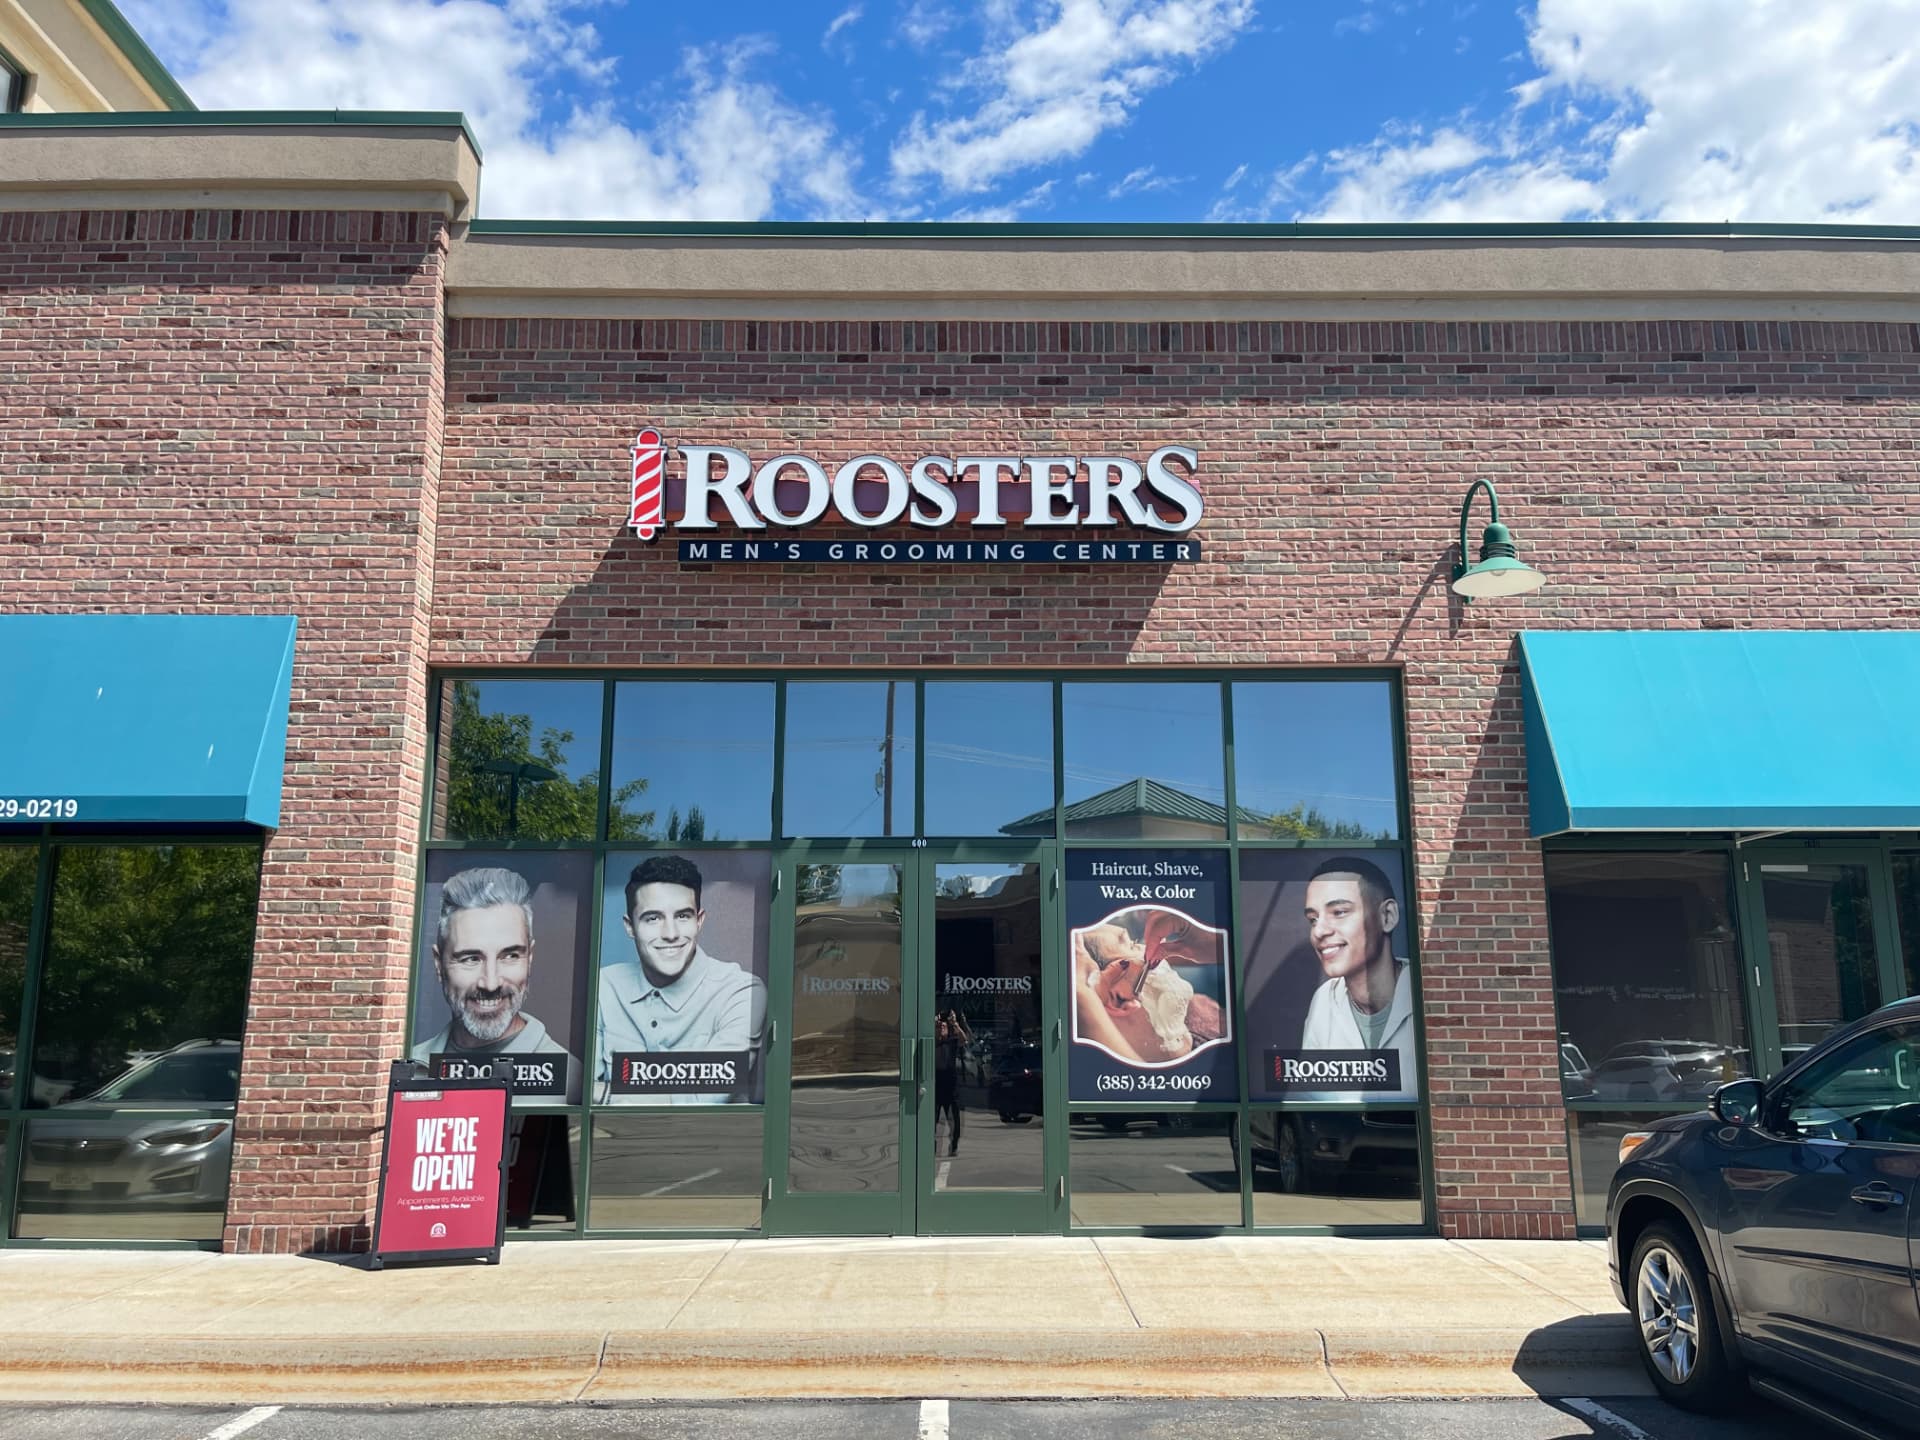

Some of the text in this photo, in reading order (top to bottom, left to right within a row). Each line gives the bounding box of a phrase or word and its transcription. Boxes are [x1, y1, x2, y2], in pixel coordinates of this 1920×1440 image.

[674, 444, 1205, 533] ROOSTERS
[689, 543, 1192, 560] MEN'S GROOMING CENTER
[911, 839, 927, 848] 600
[1091, 862, 1204, 878] Haircut, Shave,
[1100, 886, 1196, 901] Wax, & Color
[809, 976, 890, 992] ROOSTERS
[952, 976, 1032, 991] ROOSTERS
[449, 1062, 553, 1082] ROOERS
[630, 1060, 735, 1080] ROOSTERS
[1282, 1058, 1387, 1078] ROOSTERS
[1096, 1075, 1212, 1093] (385) 342-0069
[416, 1117, 479, 1153] WE'RE
[412, 1154, 475, 1192] OPEN!
[397, 1193, 485, 1206] Appointments Available
